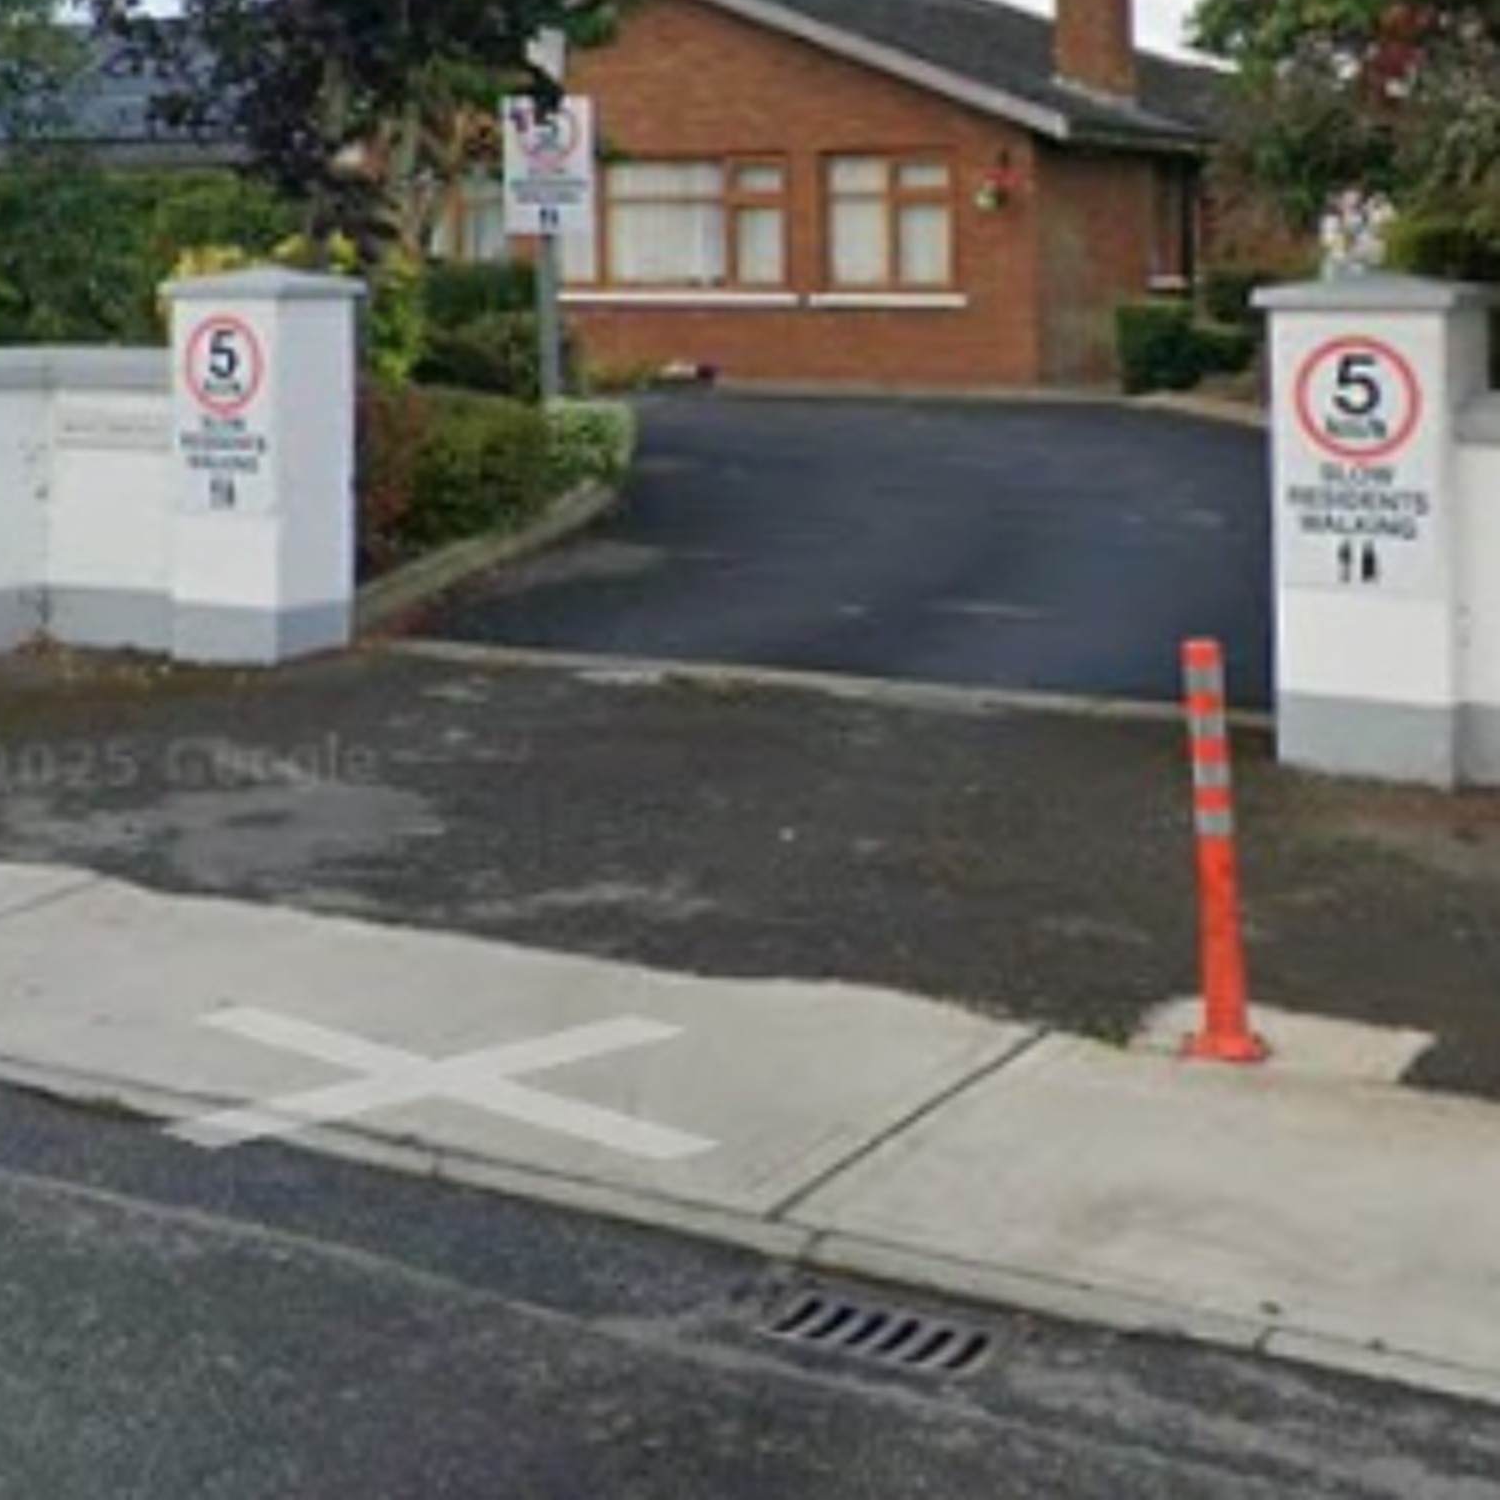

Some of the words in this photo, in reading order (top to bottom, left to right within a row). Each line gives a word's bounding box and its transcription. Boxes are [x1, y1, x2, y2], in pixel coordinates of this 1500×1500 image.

[209, 329, 239, 379] 5
[1333, 353, 1381, 415] 5
[1287, 484, 1430, 516] RESIDENTS
[1300, 513, 1417, 541] WALKING
